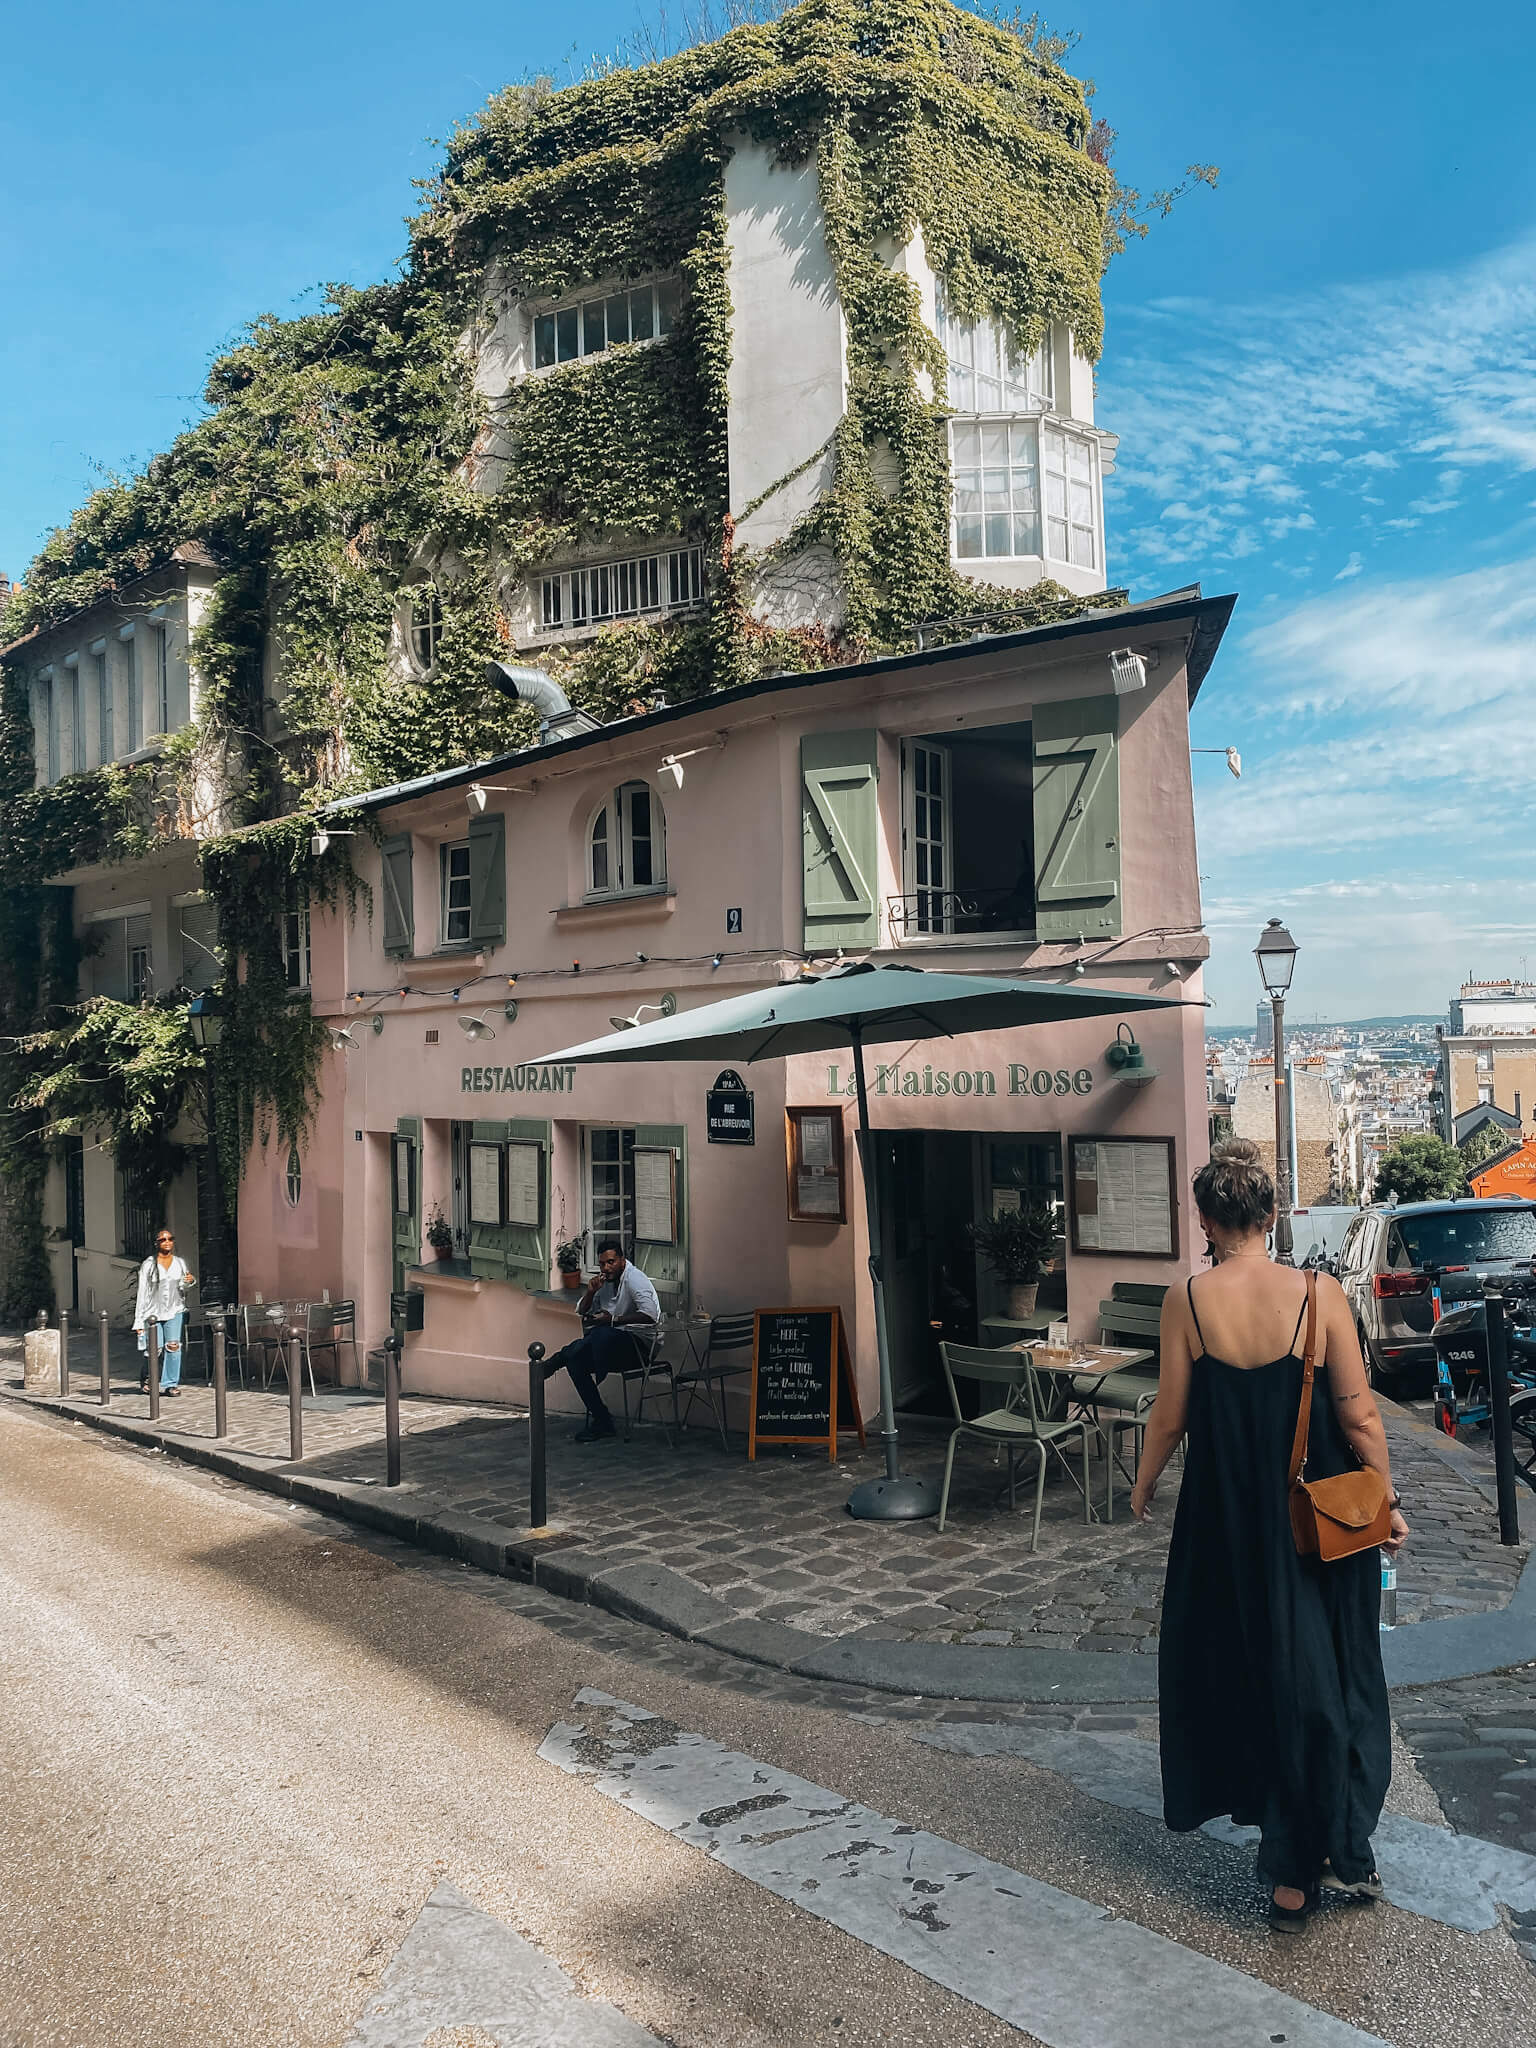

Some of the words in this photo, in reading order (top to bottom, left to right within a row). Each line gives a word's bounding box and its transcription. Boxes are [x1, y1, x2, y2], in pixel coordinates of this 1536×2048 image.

[729, 909, 739, 932] 2
[461, 1066, 577, 1093] RESTAURANT
[826, 1064, 857, 1097] La
[874, 1063, 998, 1097] Maison
[1007, 1063, 1094, 1097] Rose
[723, 1103, 735, 1114] RUE
[710, 1117, 717, 1127] DE
[718, 1117, 751, 1129] L'ABREUVOIR
[1447, 1350, 1475, 1361] 1246
[789, 1361, 813, 1375] LUNCH
